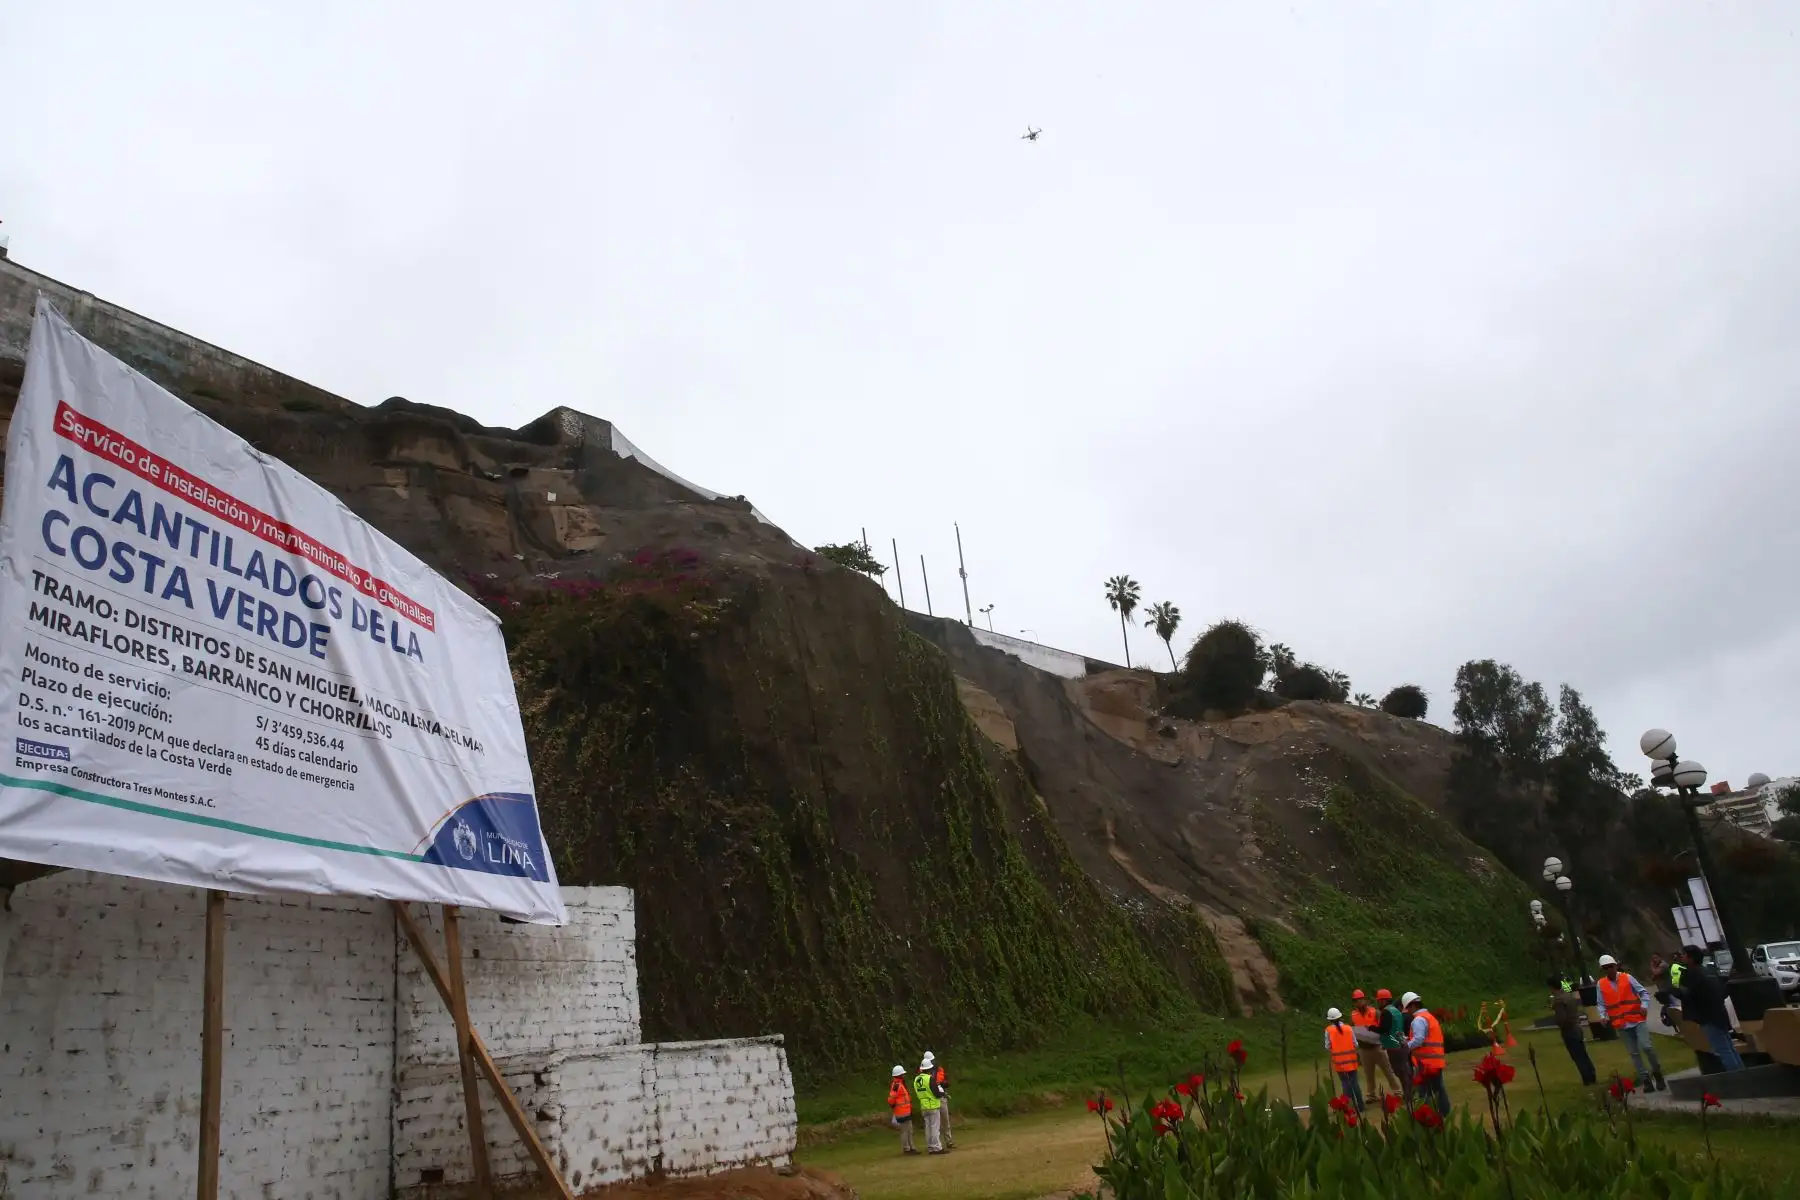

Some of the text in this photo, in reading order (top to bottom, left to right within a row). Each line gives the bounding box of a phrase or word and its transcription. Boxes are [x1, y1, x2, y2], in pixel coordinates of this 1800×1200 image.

[60, 410, 136, 464] Servicio
[138, 456, 160, 479] de
[164, 466, 248, 524] instalación
[252, 516, 262, 532] y
[263, 522, 360, 586] mantenimiento
[380, 588, 433, 626] geomallas
[42, 510, 330, 659] COSTA VERDE
[47, 454, 424, 664] ACANTILADOS DE LA
[21, 666, 172, 724] Plazo de ejecución:
[24, 642, 171, 700] Monto de servicio:
[29, 602, 392, 739] MIRAFLORES, BARRANCO Y CHORRILLOS
[32, 570, 485, 756] TRAMO: DISTRITOS DE SAN MIGUEL, MAGDALENA DEL MAR
[18, 692, 48, 712] D.S.
[78, 708, 136, 732] 161-2019
[138, 724, 164, 742] PCM
[168, 736, 190, 749] que
[192, 740, 234, 760] declara
[236, 753, 249, 764] en
[251, 758, 284, 774] estado
[286, 766, 298, 778] de
[300, 771, 354, 791] emergencia
[18, 712, 232, 776] los acantilados de la Costa Verde
[18, 742, 69, 759] EJECUTA:
[256, 716, 269, 732] S/
[256, 736, 358, 774] 45 días calendario
[16, 757, 216, 808] Empresa Constructora Tres Montes S.A.C.
